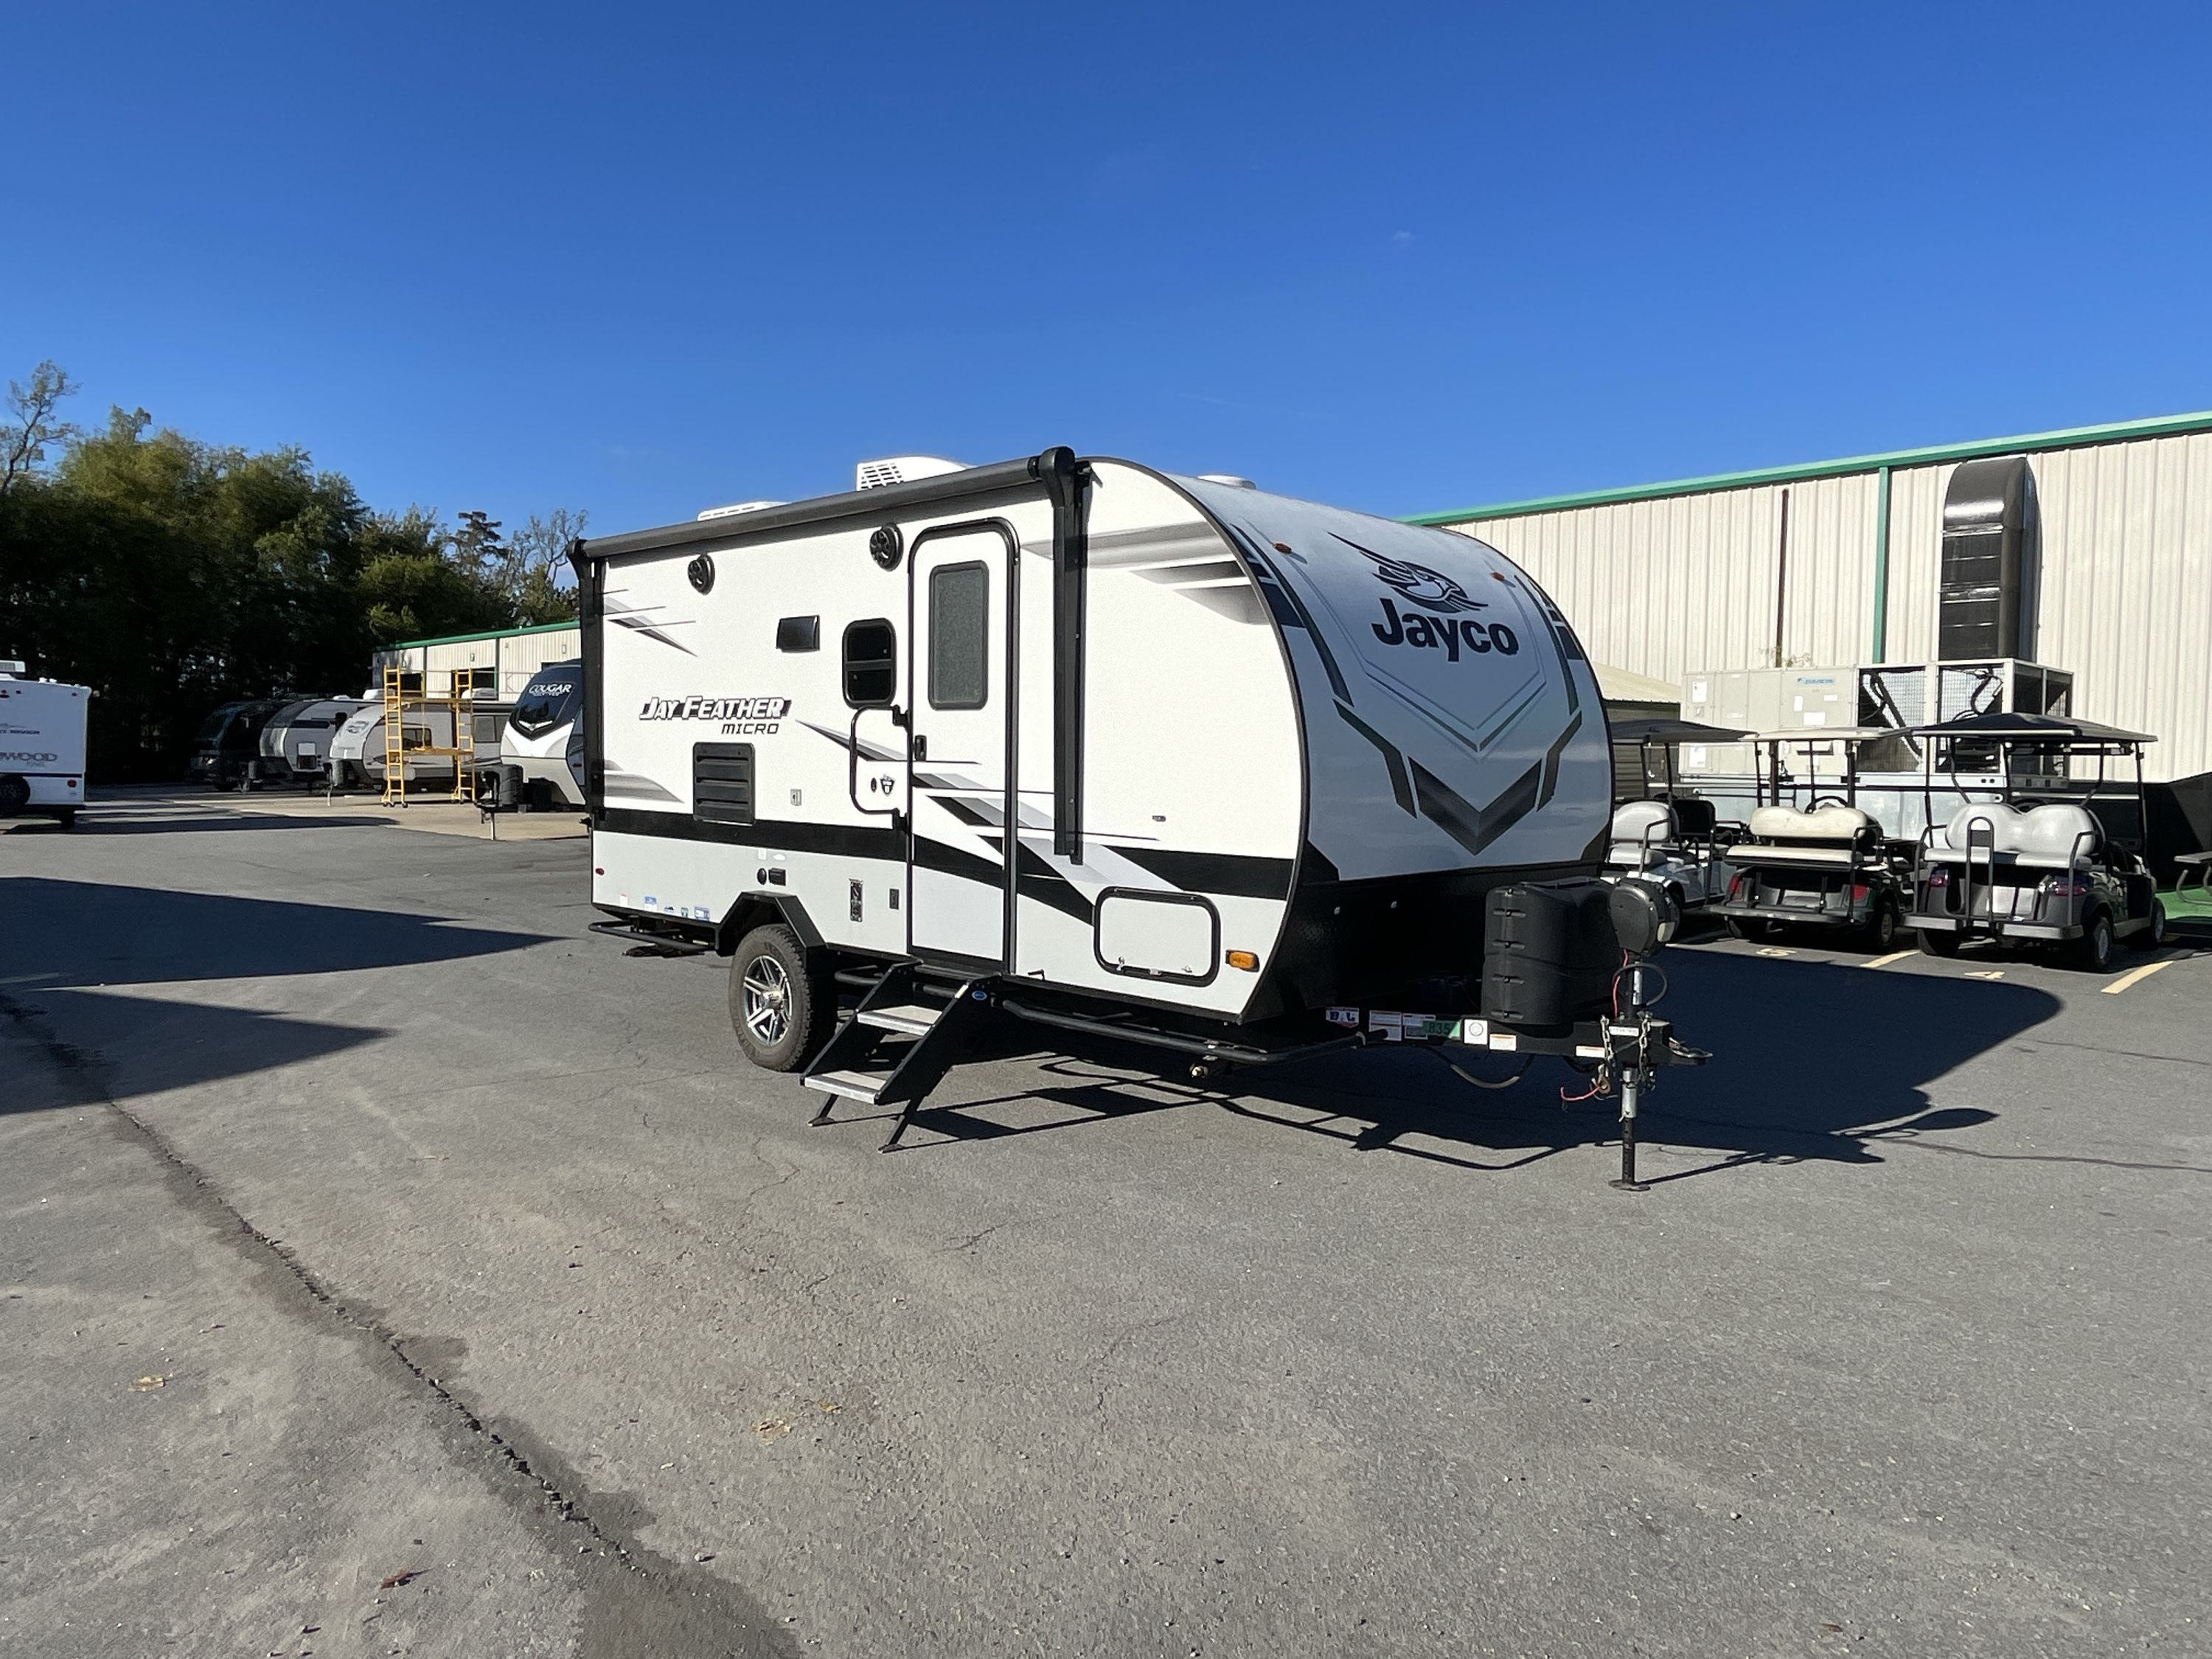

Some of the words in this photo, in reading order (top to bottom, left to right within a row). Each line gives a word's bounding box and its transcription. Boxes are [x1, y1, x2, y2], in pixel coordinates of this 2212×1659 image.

[1371, 597, 1520, 662] Jayco
[529, 684, 572, 694] COUGAR
[639, 697, 681, 720] JAY
[681, 696, 786, 720] FEATHER
[721, 723, 779, 734] MICRO
[1964, 971, 2006, 980] 4
